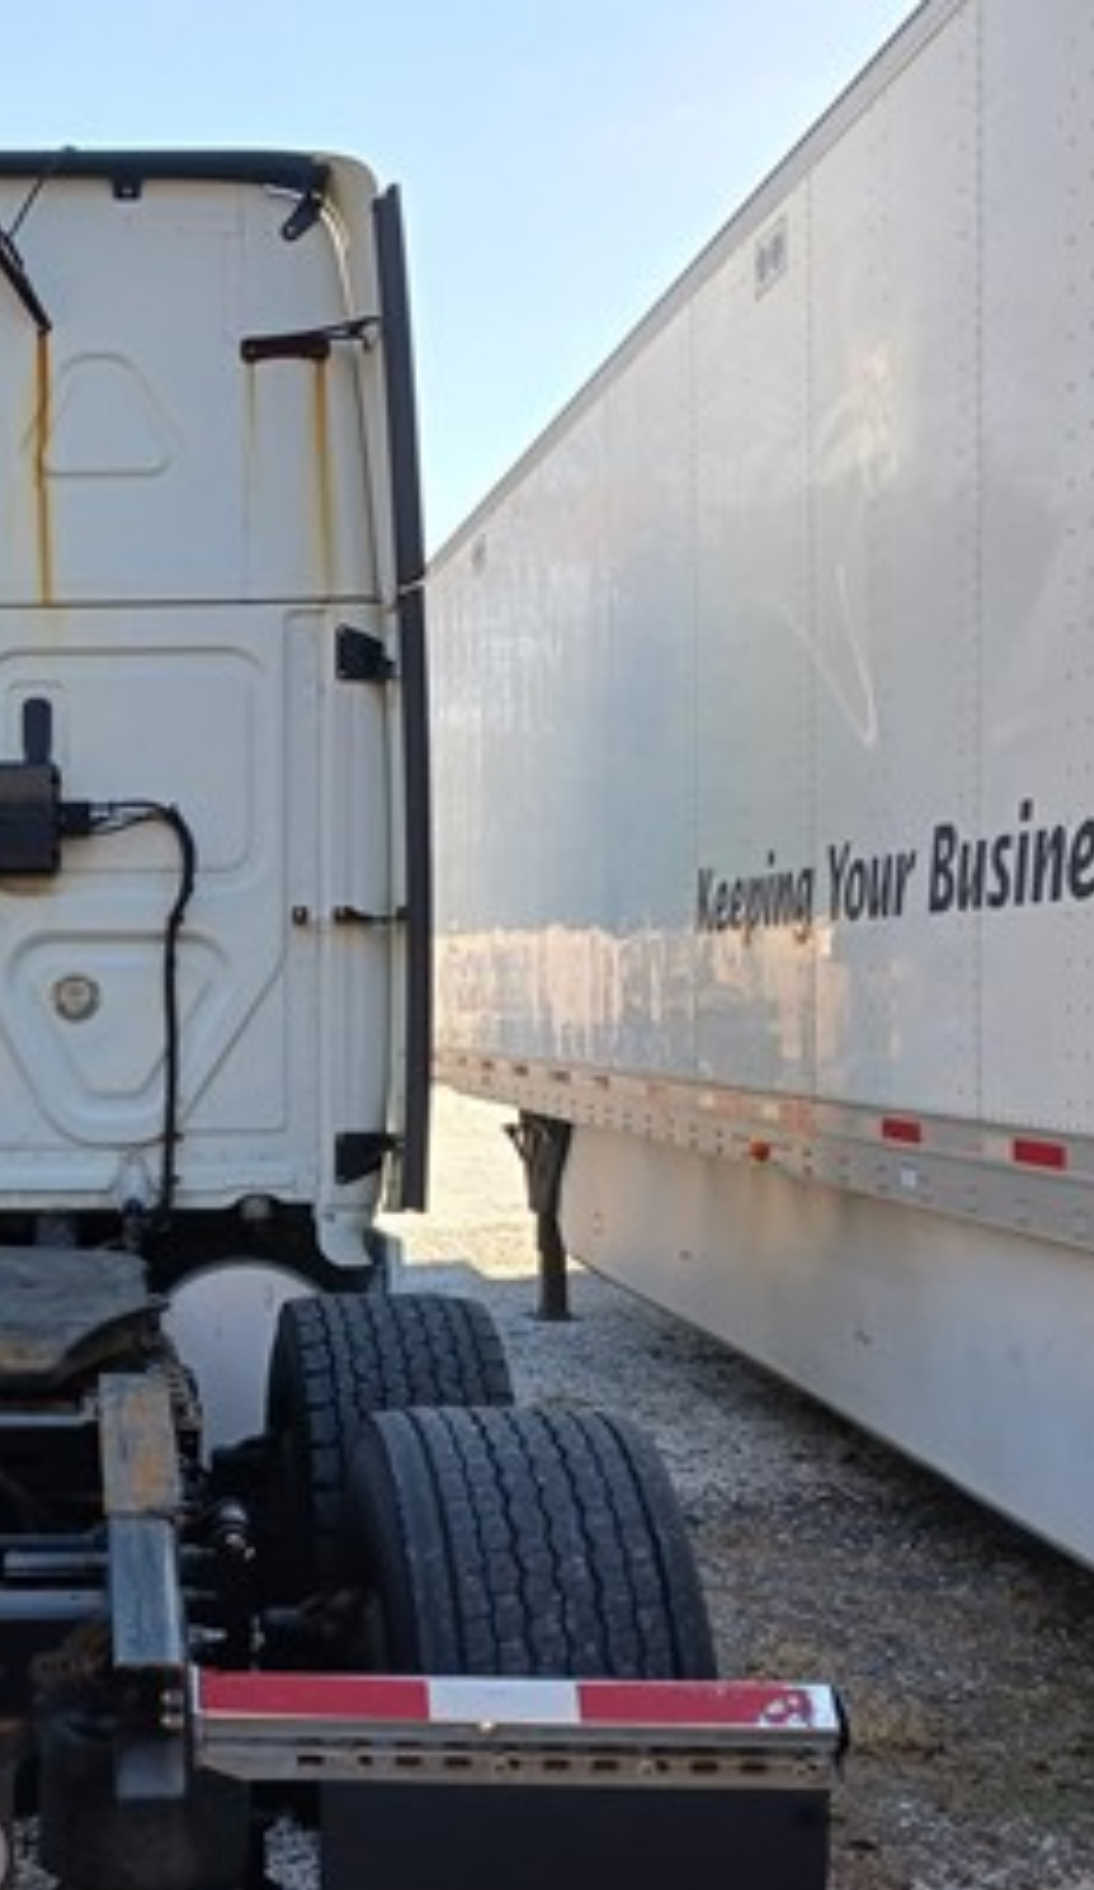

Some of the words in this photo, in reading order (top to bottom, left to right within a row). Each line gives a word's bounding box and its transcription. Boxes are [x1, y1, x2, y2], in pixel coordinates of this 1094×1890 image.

[697, 850, 814, 945] Keeping
[828, 842, 917, 921] Your
[929, 799, 1094, 913] Busine
